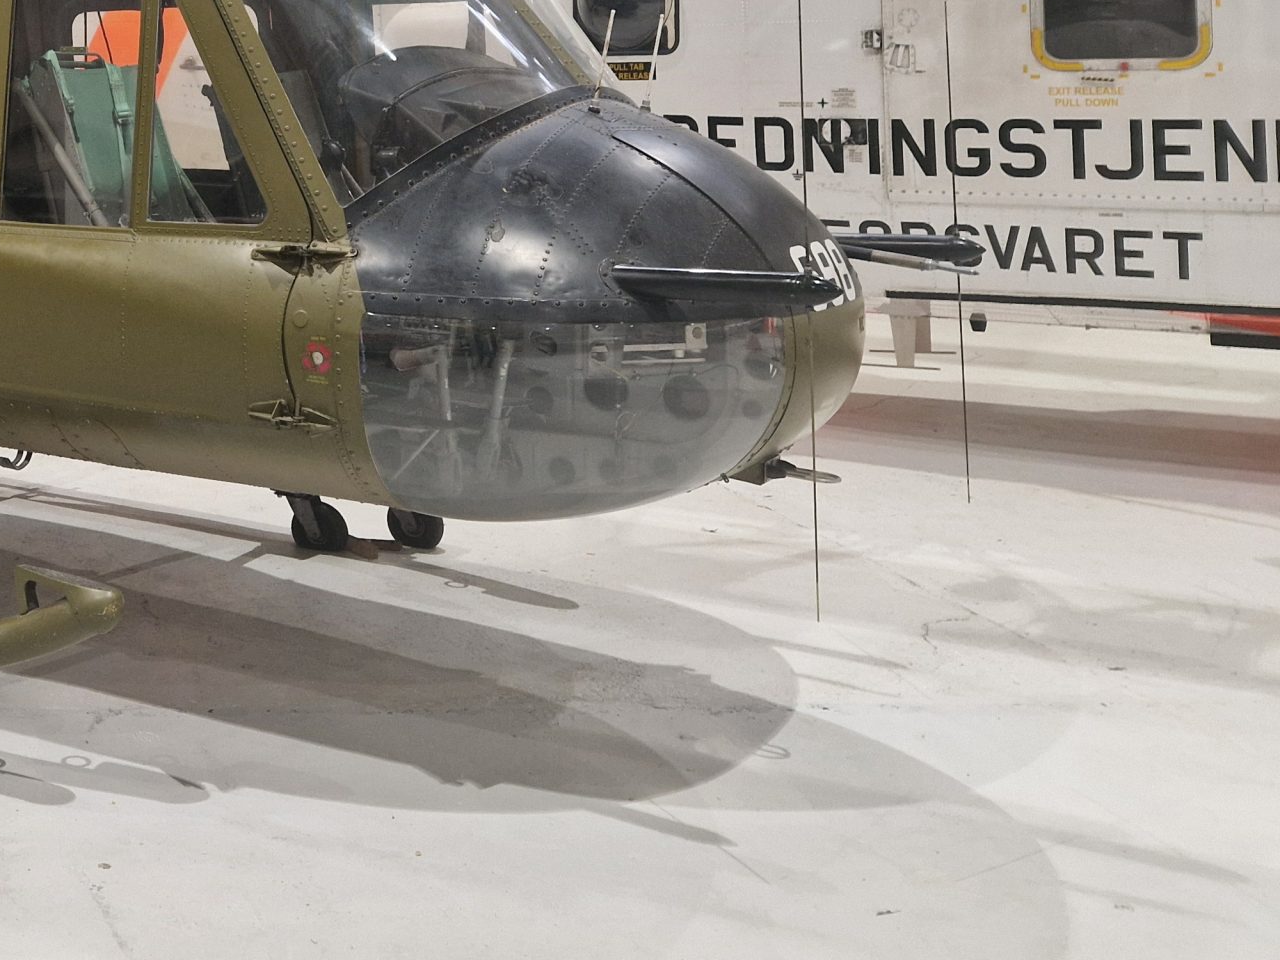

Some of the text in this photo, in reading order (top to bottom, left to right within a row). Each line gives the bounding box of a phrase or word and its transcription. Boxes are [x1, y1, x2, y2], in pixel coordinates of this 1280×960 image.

[609, 63, 645, 71] PULL TAB
[1048, 86, 1124, 96] EXIT RELEASE
[1055, 98, 1119, 107] PULL DOWN
[663, 115, 1280, 182] EDNINGSTJEN
